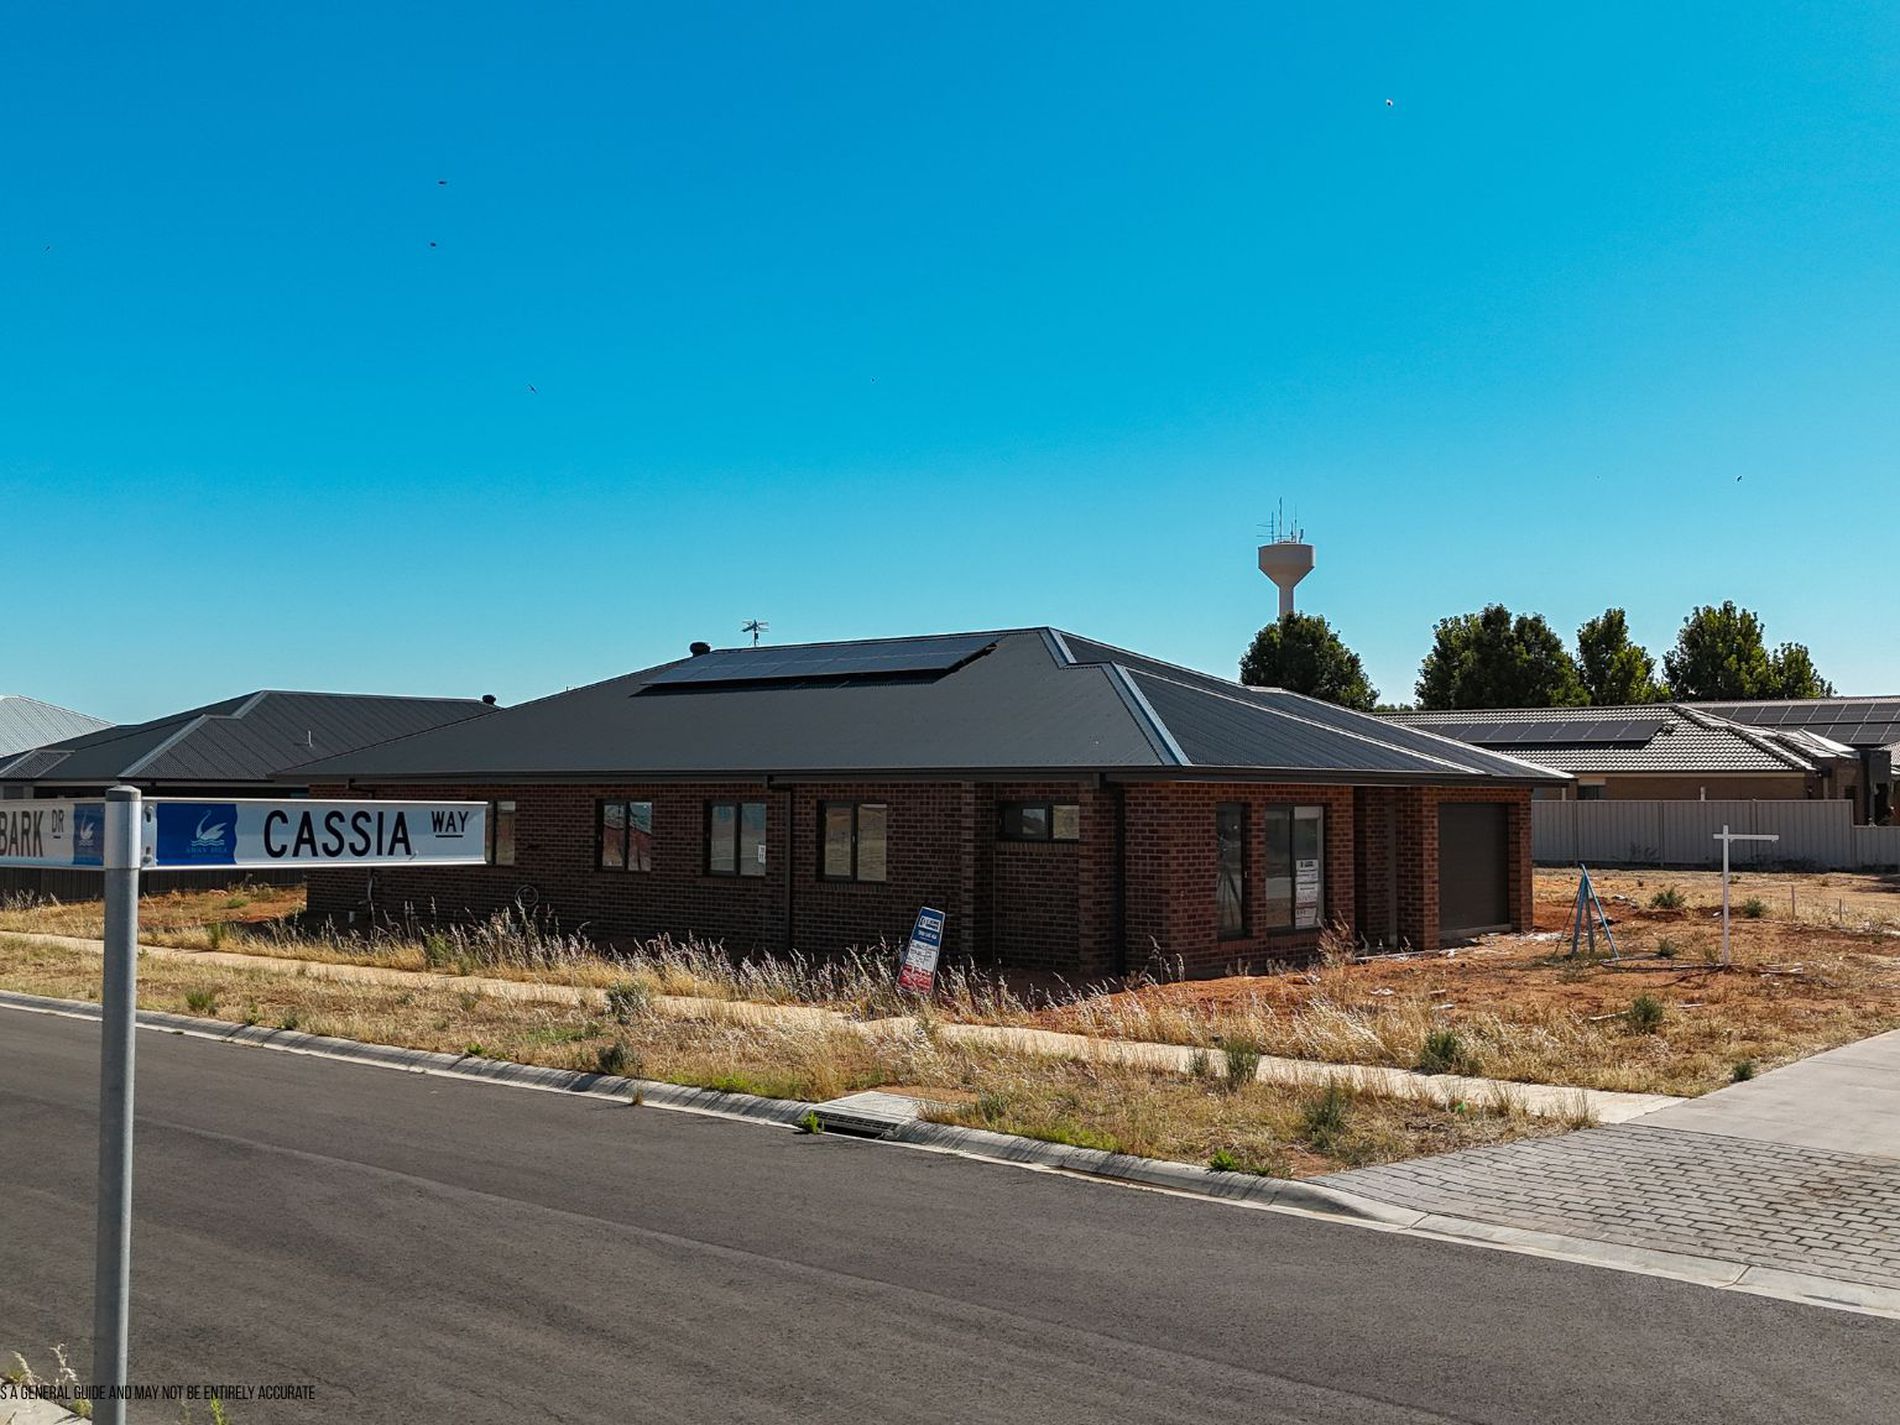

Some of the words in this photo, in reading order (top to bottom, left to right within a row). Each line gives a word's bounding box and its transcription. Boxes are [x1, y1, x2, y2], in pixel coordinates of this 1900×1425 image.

[0, 810, 44, 858] BARK
[51, 809, 65, 833] DR
[263, 809, 412, 858] CASSIA
[431, 810, 469, 833] WAY
